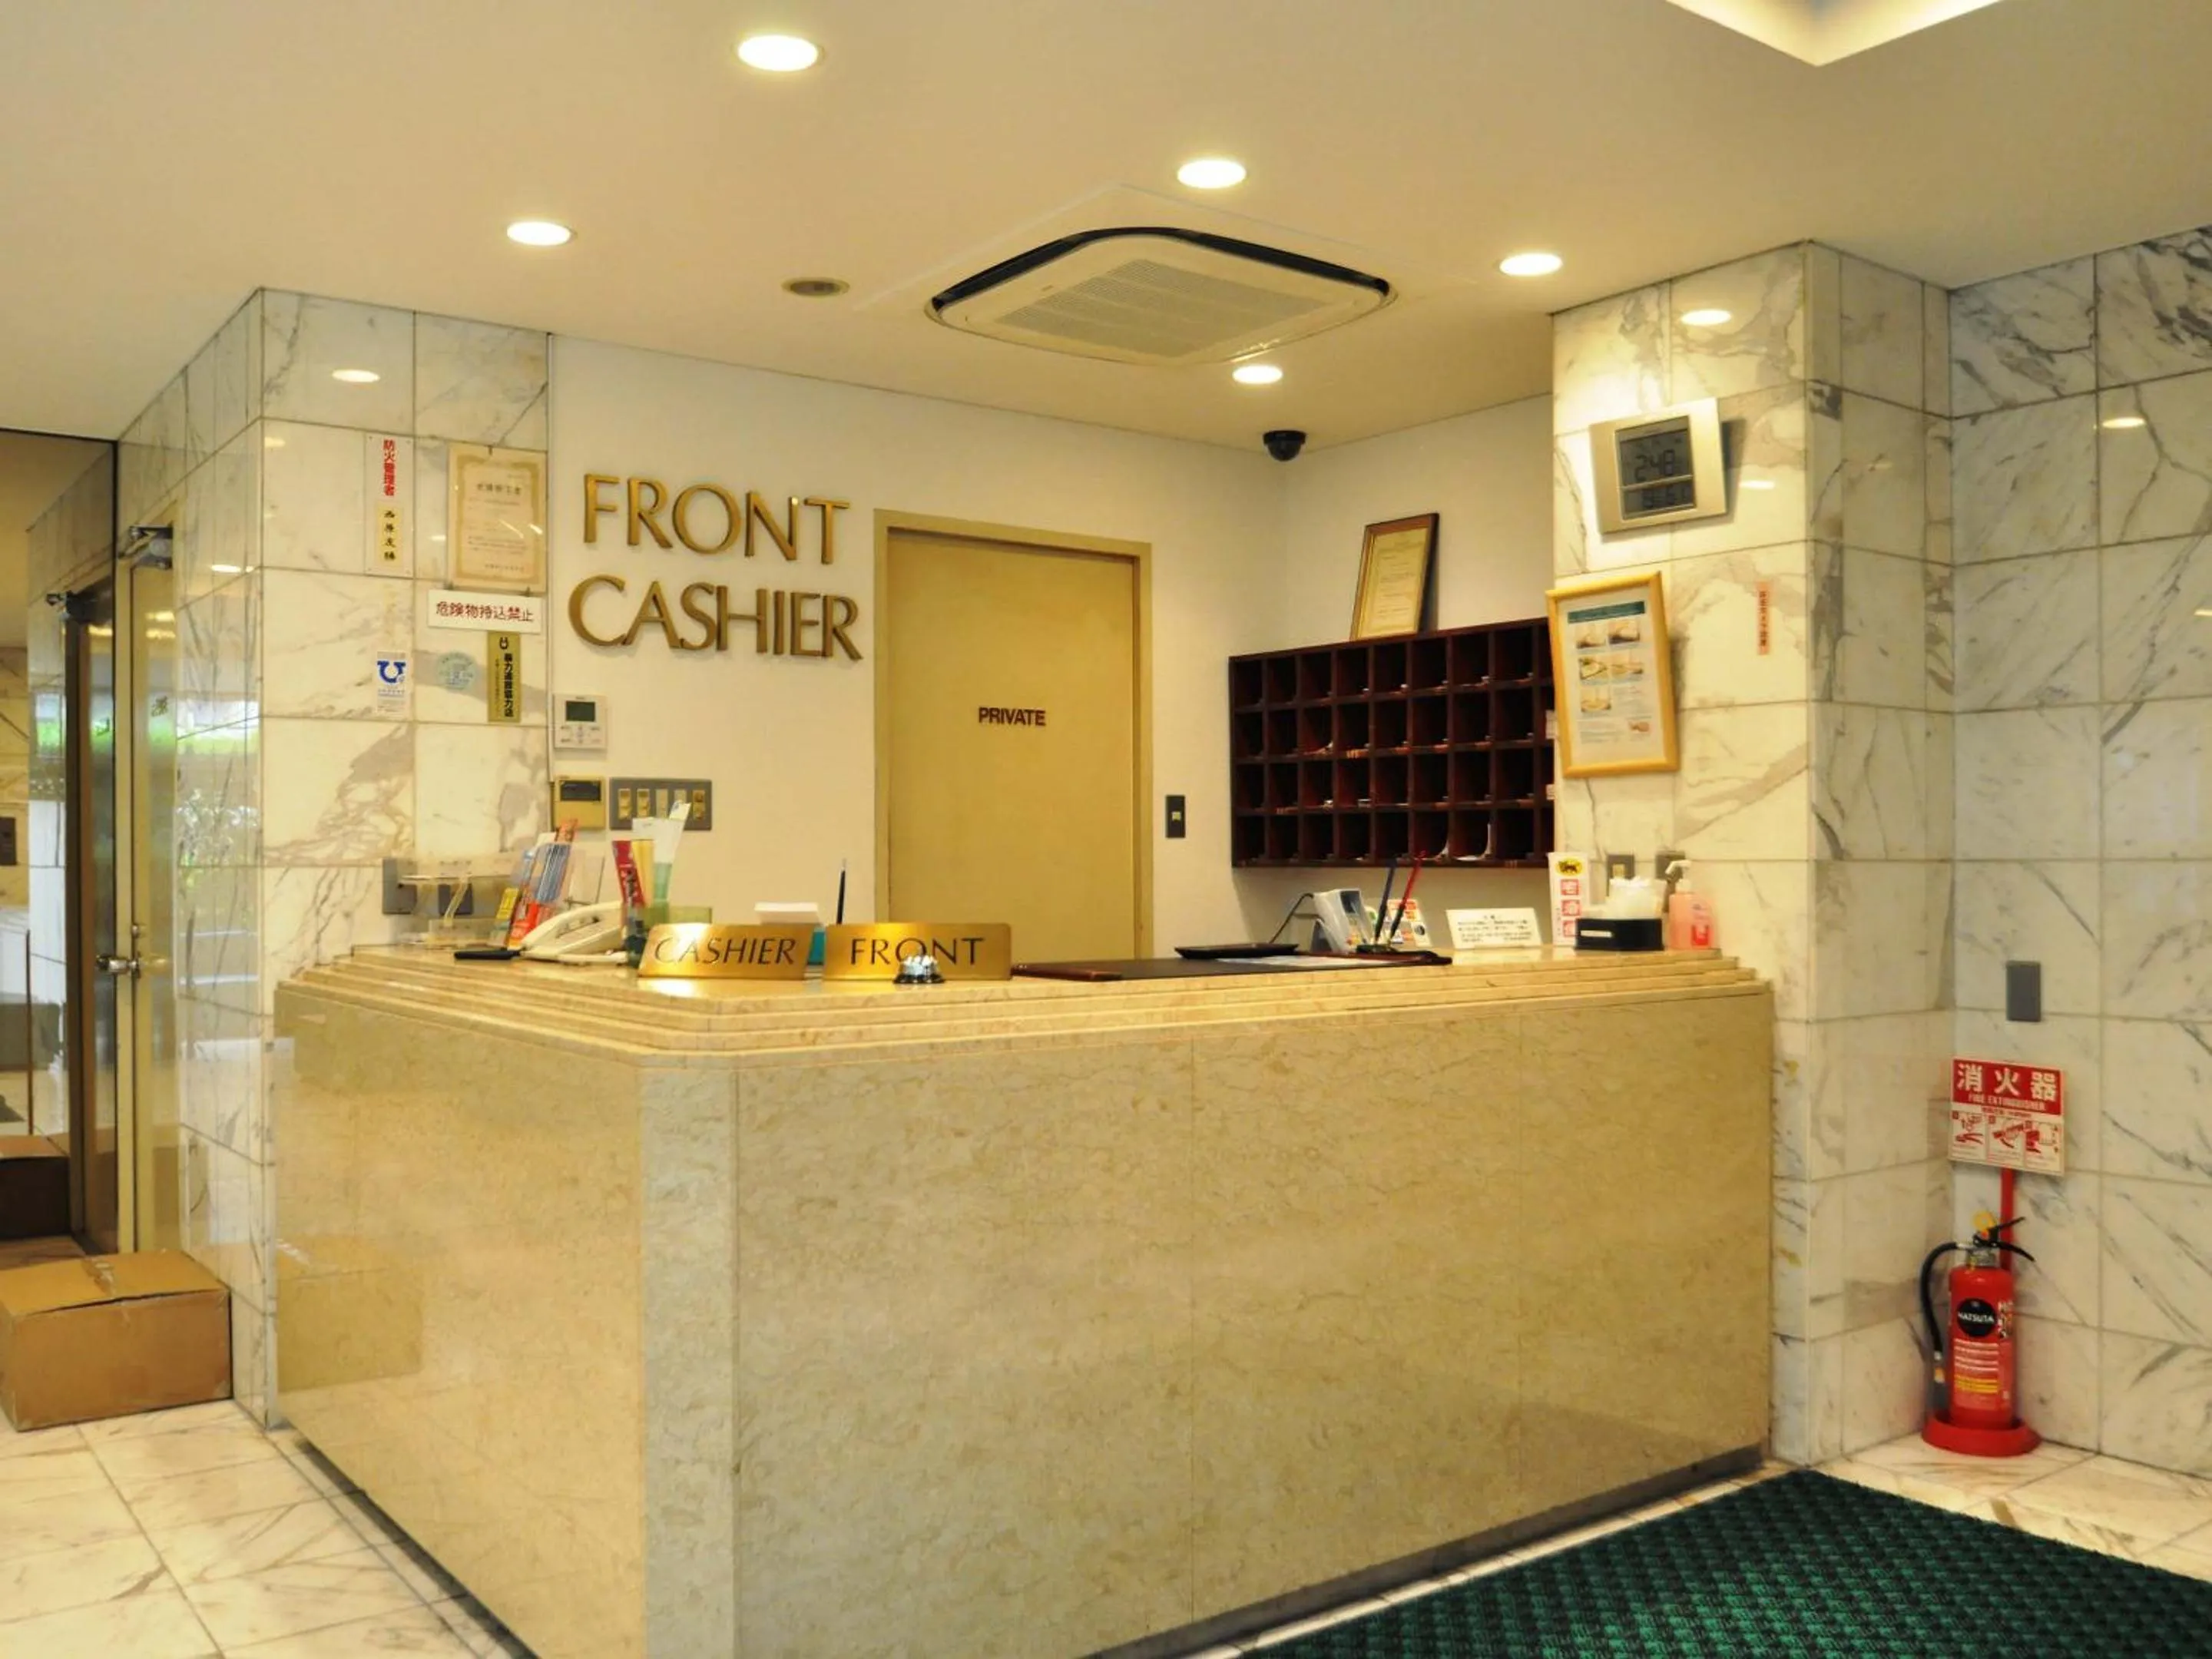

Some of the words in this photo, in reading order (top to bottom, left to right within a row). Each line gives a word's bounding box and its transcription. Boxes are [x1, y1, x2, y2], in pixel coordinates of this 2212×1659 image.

[583, 473, 850, 565] FRONT
[568, 575, 864, 661] CASHIER
[979, 707, 1046, 727] PRIVATE
[654, 936, 796, 965] CASHIER
[850, 937, 985, 965] FRONT
[1956, 1062, 2057, 1102] 消火器
